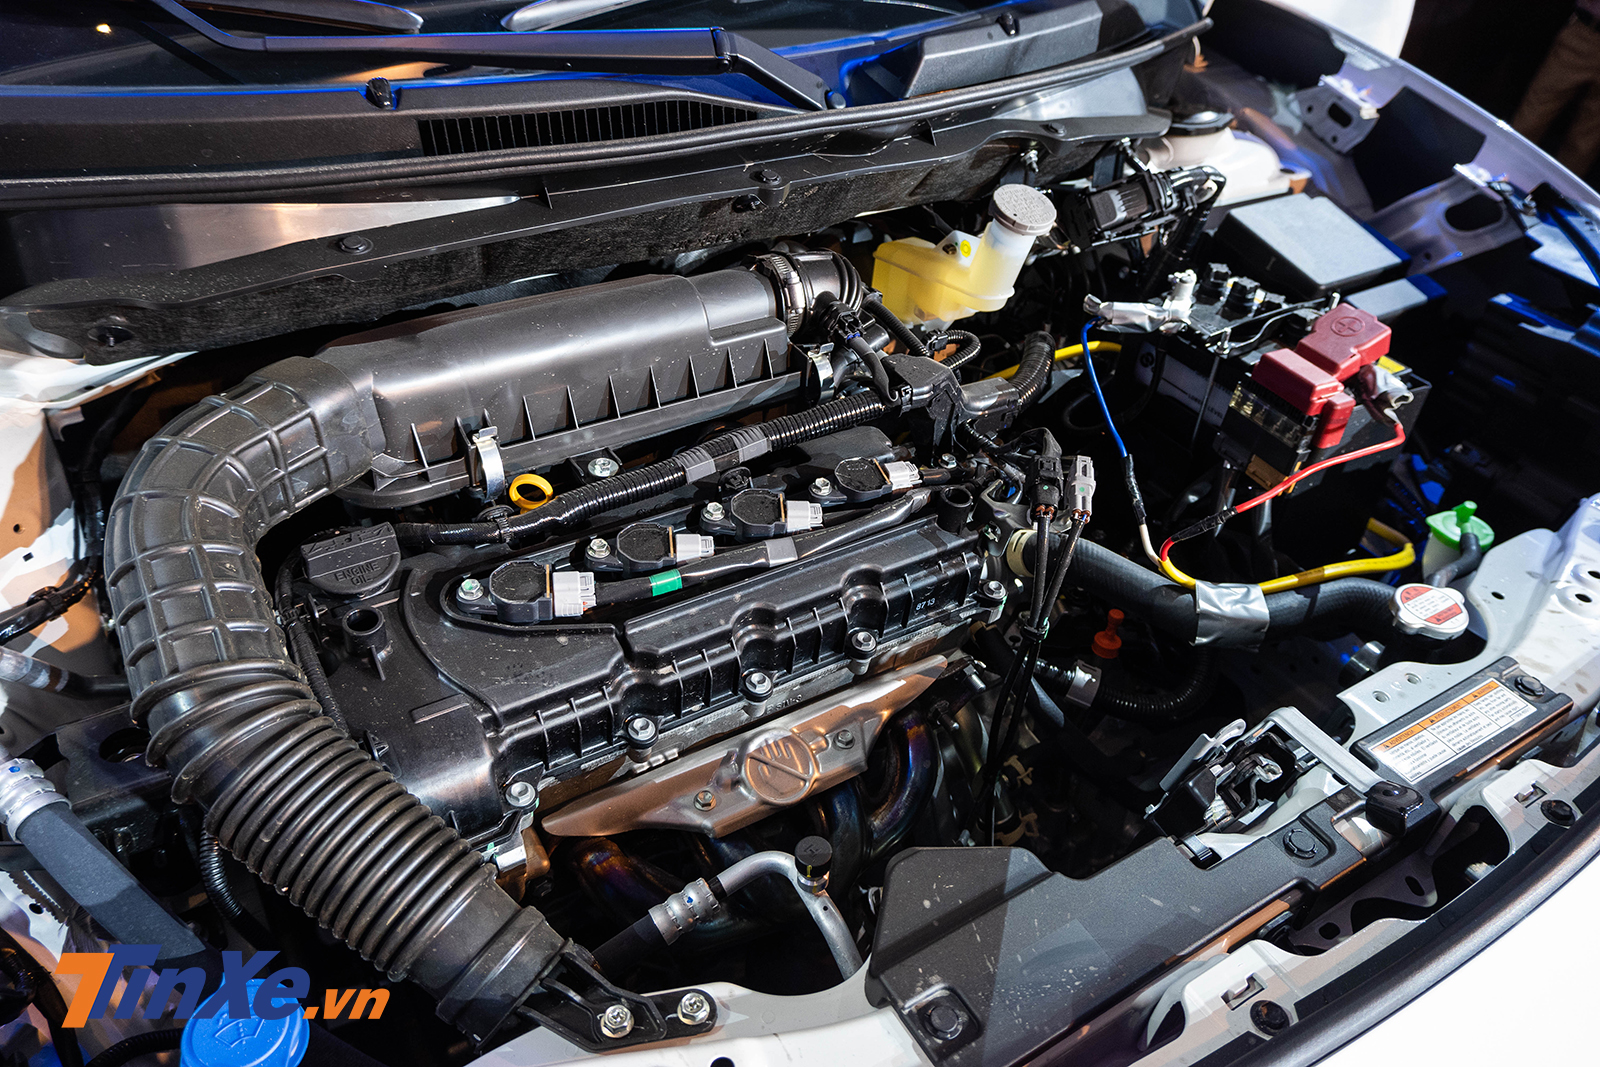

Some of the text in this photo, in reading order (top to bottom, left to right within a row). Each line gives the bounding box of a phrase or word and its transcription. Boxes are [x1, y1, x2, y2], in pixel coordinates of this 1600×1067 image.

[335, 562, 381, 582] ENGINE
[351, 576, 374, 586] OIL
[1389, 729, 1415, 746] ADVERTENCIA
